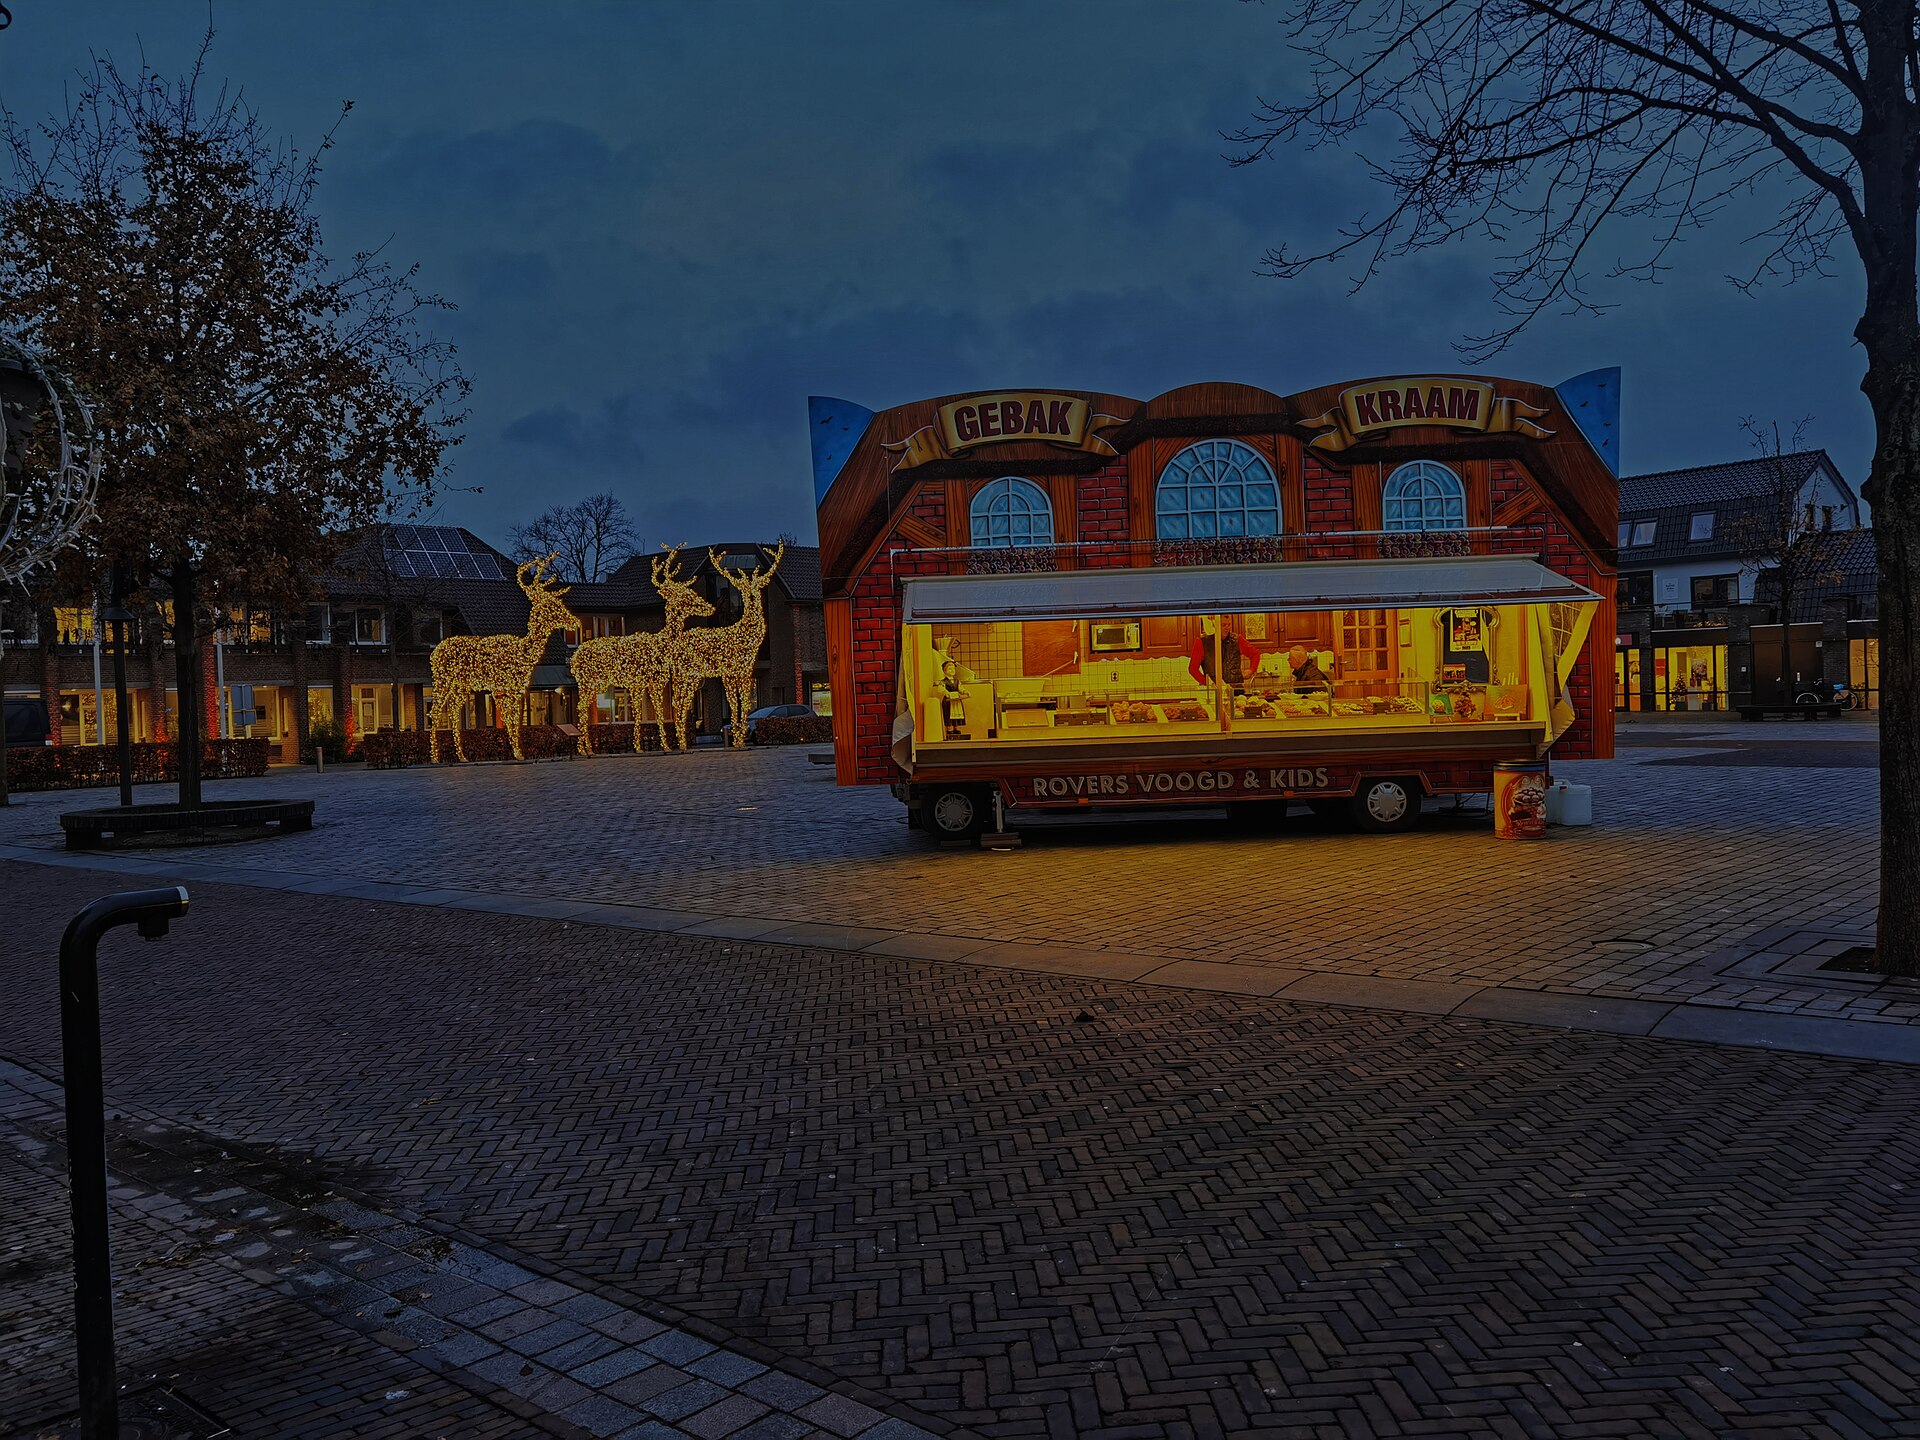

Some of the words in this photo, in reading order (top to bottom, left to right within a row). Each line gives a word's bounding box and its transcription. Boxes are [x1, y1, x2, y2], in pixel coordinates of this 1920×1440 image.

[954, 399, 1073, 442] GEBAK
[1355, 386, 1480, 426] KRAAM
[1033, 774, 1129, 797] ROVERS
[1136, 771, 1235, 794] VOOGD
[1243, 769, 1260, 789] &
[1269, 767, 1329, 790] KIDS
